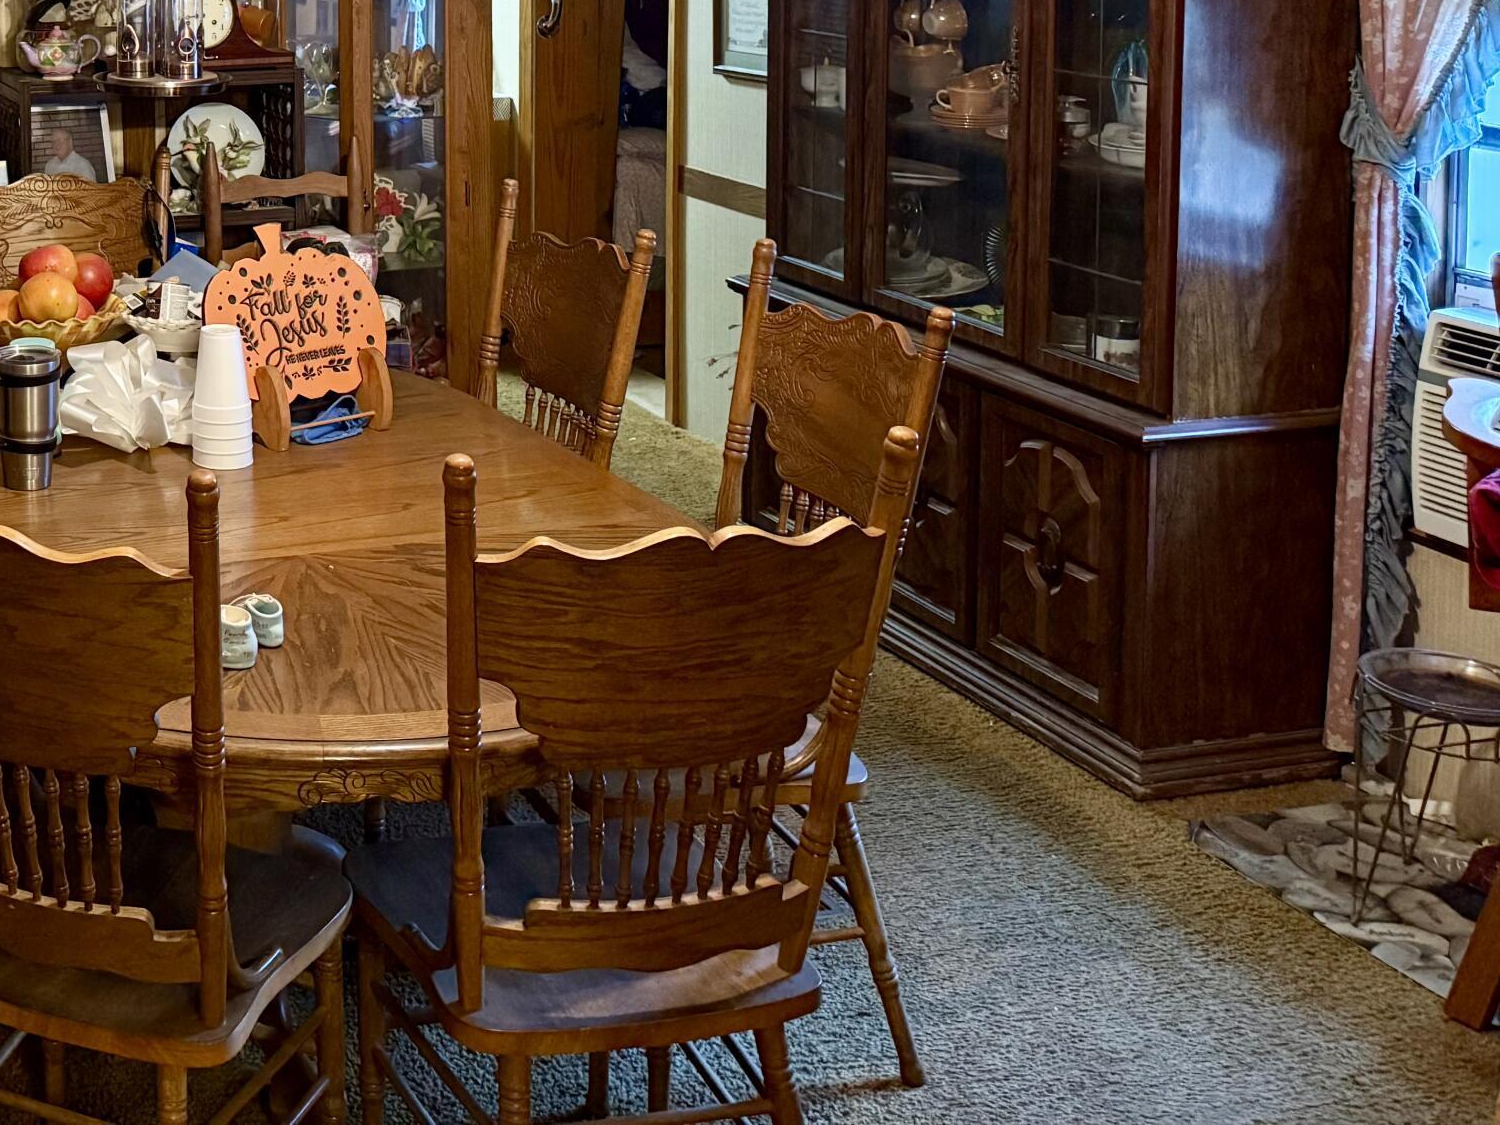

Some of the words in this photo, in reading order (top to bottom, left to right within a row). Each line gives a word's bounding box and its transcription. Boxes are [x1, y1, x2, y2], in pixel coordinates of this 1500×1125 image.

[240, 289, 292, 321] Fall
[295, 290, 328, 320] for
[260, 311, 328, 367] Jesus
[285, 354, 296, 365] HE
[296, 350, 320, 362] NEVER
[320, 345, 346, 358] LEAVES
